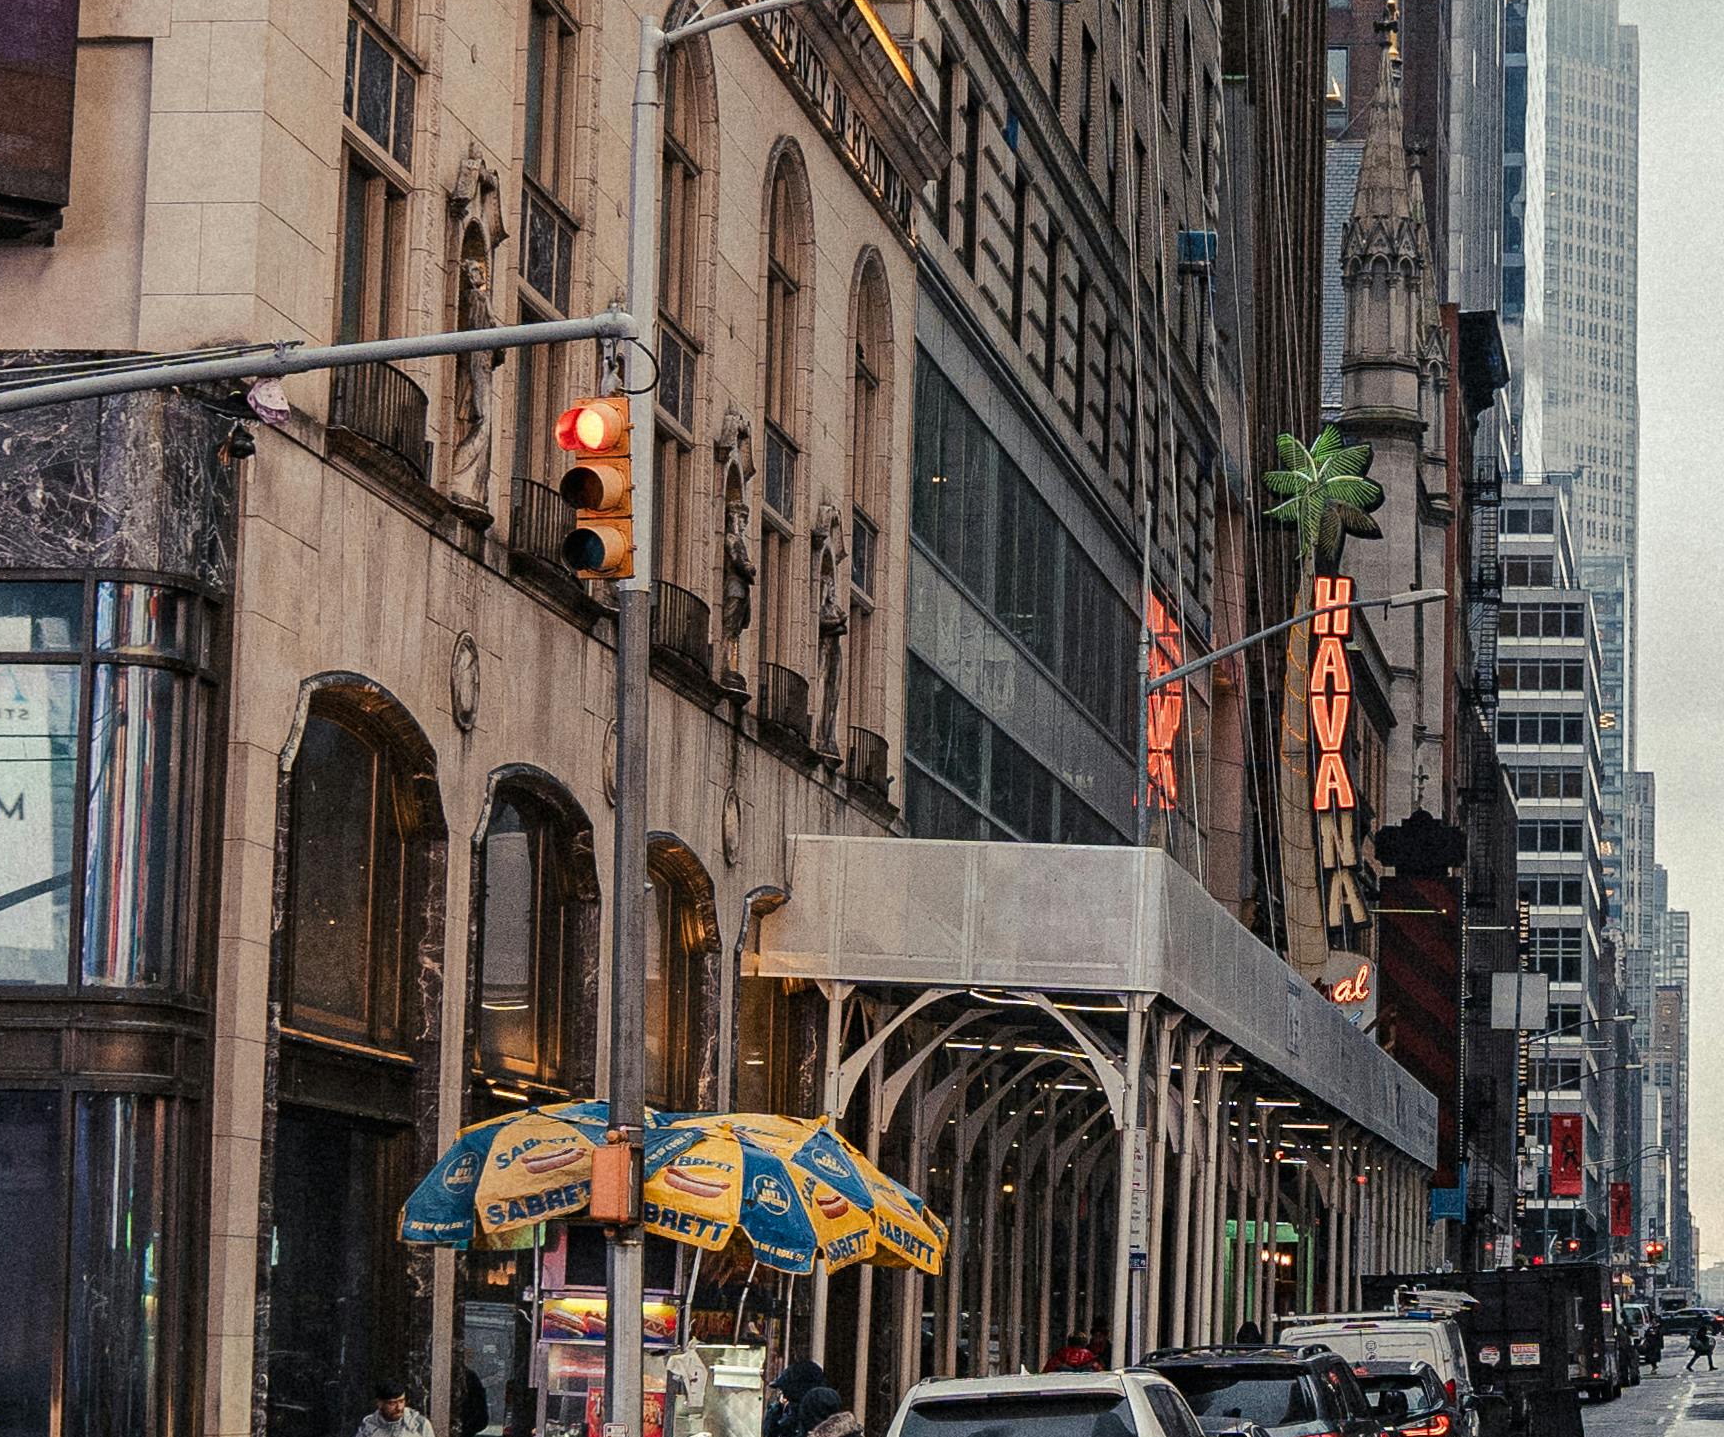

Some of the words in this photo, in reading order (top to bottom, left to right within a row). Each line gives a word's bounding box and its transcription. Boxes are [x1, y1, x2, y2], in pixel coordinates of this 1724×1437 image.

[1311, 576, 1369, 929] HAVANA
[643, 1201, 730, 1243] BRETT
[878, 1216, 936, 1265] SABRETT
